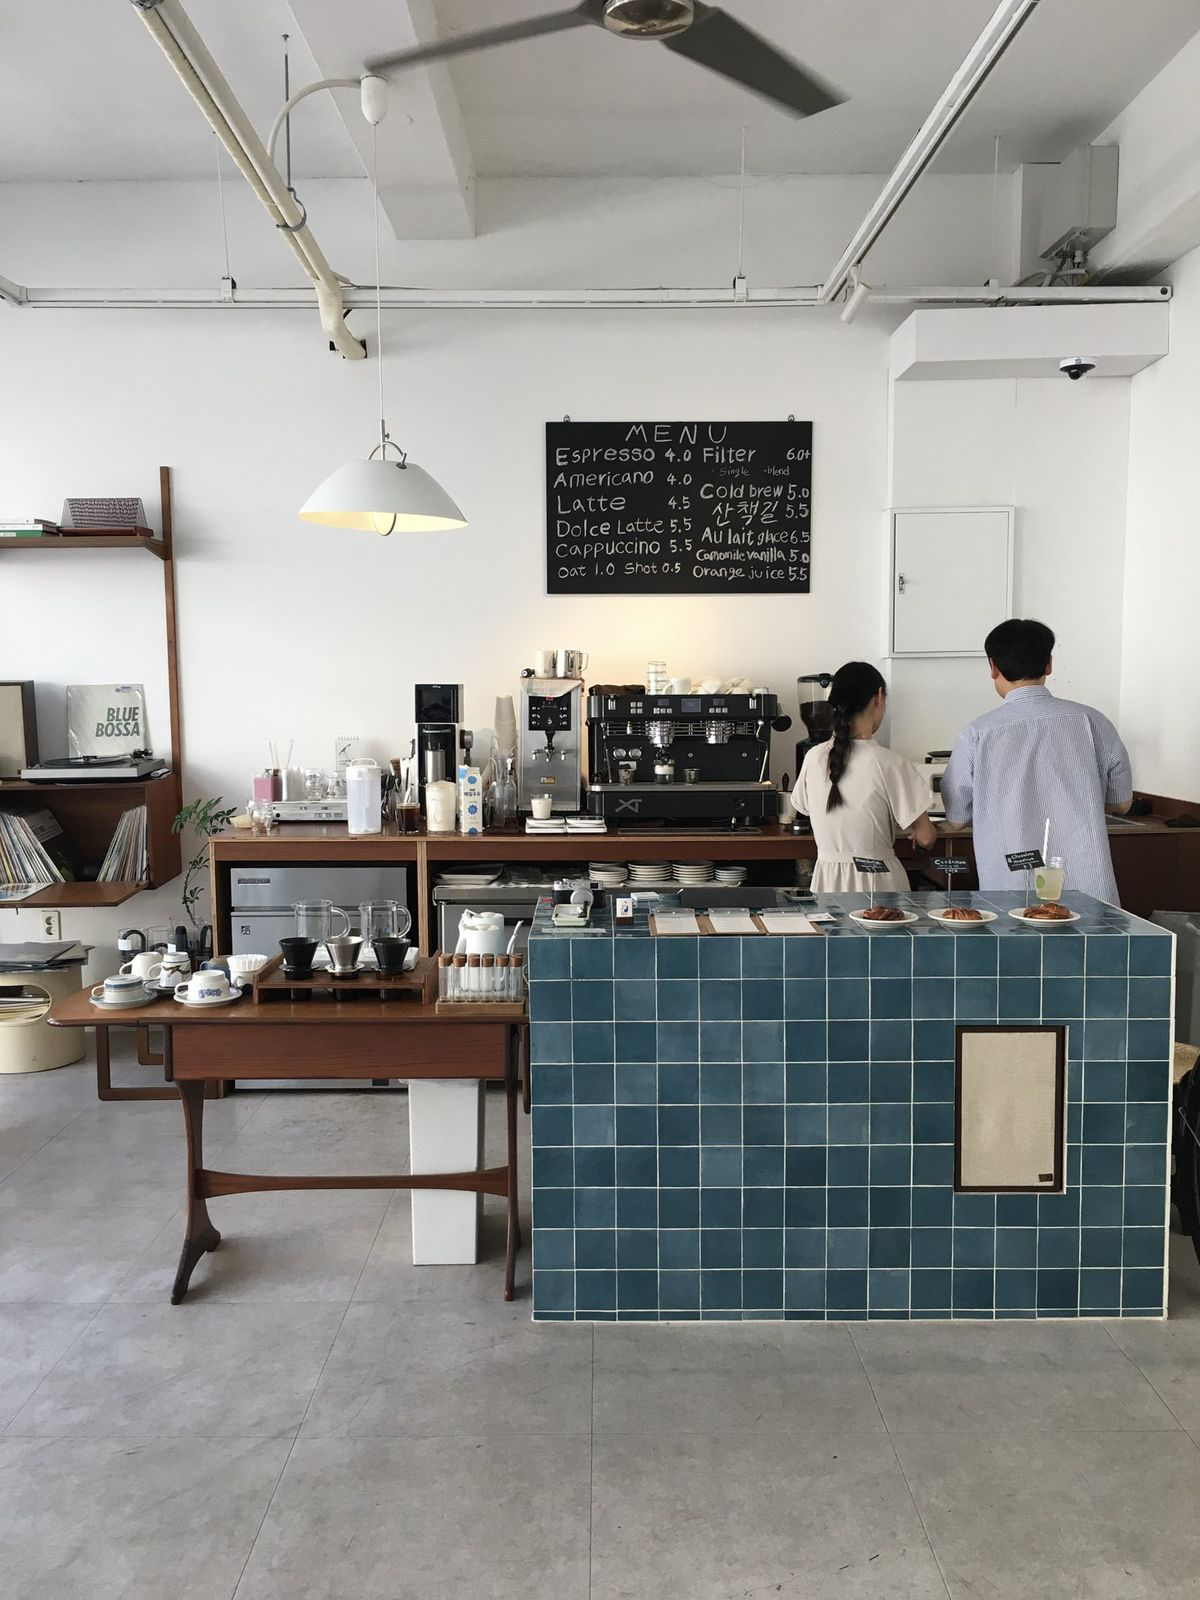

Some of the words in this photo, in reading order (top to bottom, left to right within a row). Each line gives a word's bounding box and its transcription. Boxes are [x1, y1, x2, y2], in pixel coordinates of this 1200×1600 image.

[626, 424, 727, 445] MENU
[556, 447, 656, 466] Espresso
[664, 448, 692, 463] 4.0
[703, 446, 757, 464] Filter
[553, 470, 654, 489] Americano
[666, 472, 693, 486] 4.0
[700, 483, 745, 499] Cold
[749, 484, 784, 498] brew
[787, 483, 810, 501] 5.0
[557, 495, 627, 515] Latte
[667, 495, 691, 510] 4.5
[711, 500, 779, 527] 산책길
[785, 502, 810, 519] 5.5
[556, 519, 611, 538] Dolce
[617, 517, 665, 535] Latte
[670, 517, 693, 534] 5.5
[701, 526, 723, 544] Au
[727, 527, 755, 546] lait
[790, 530, 811, 544] 6.5
[555, 537, 661, 559] Cappuccino
[669, 538, 694, 554] 5.5
[746, 546, 786, 563] vanilla
[788, 548, 810, 563] 5.0
[595, 562, 616, 576] 1.0
[662, 562, 681, 574] 0.5
[692, 565, 746, 581] Orange
[748, 566, 786, 580] juice
[788, 566, 808, 581] 5.5
[106, 706, 140, 722] BLUE
[95, 722, 140, 737] BOSSA
